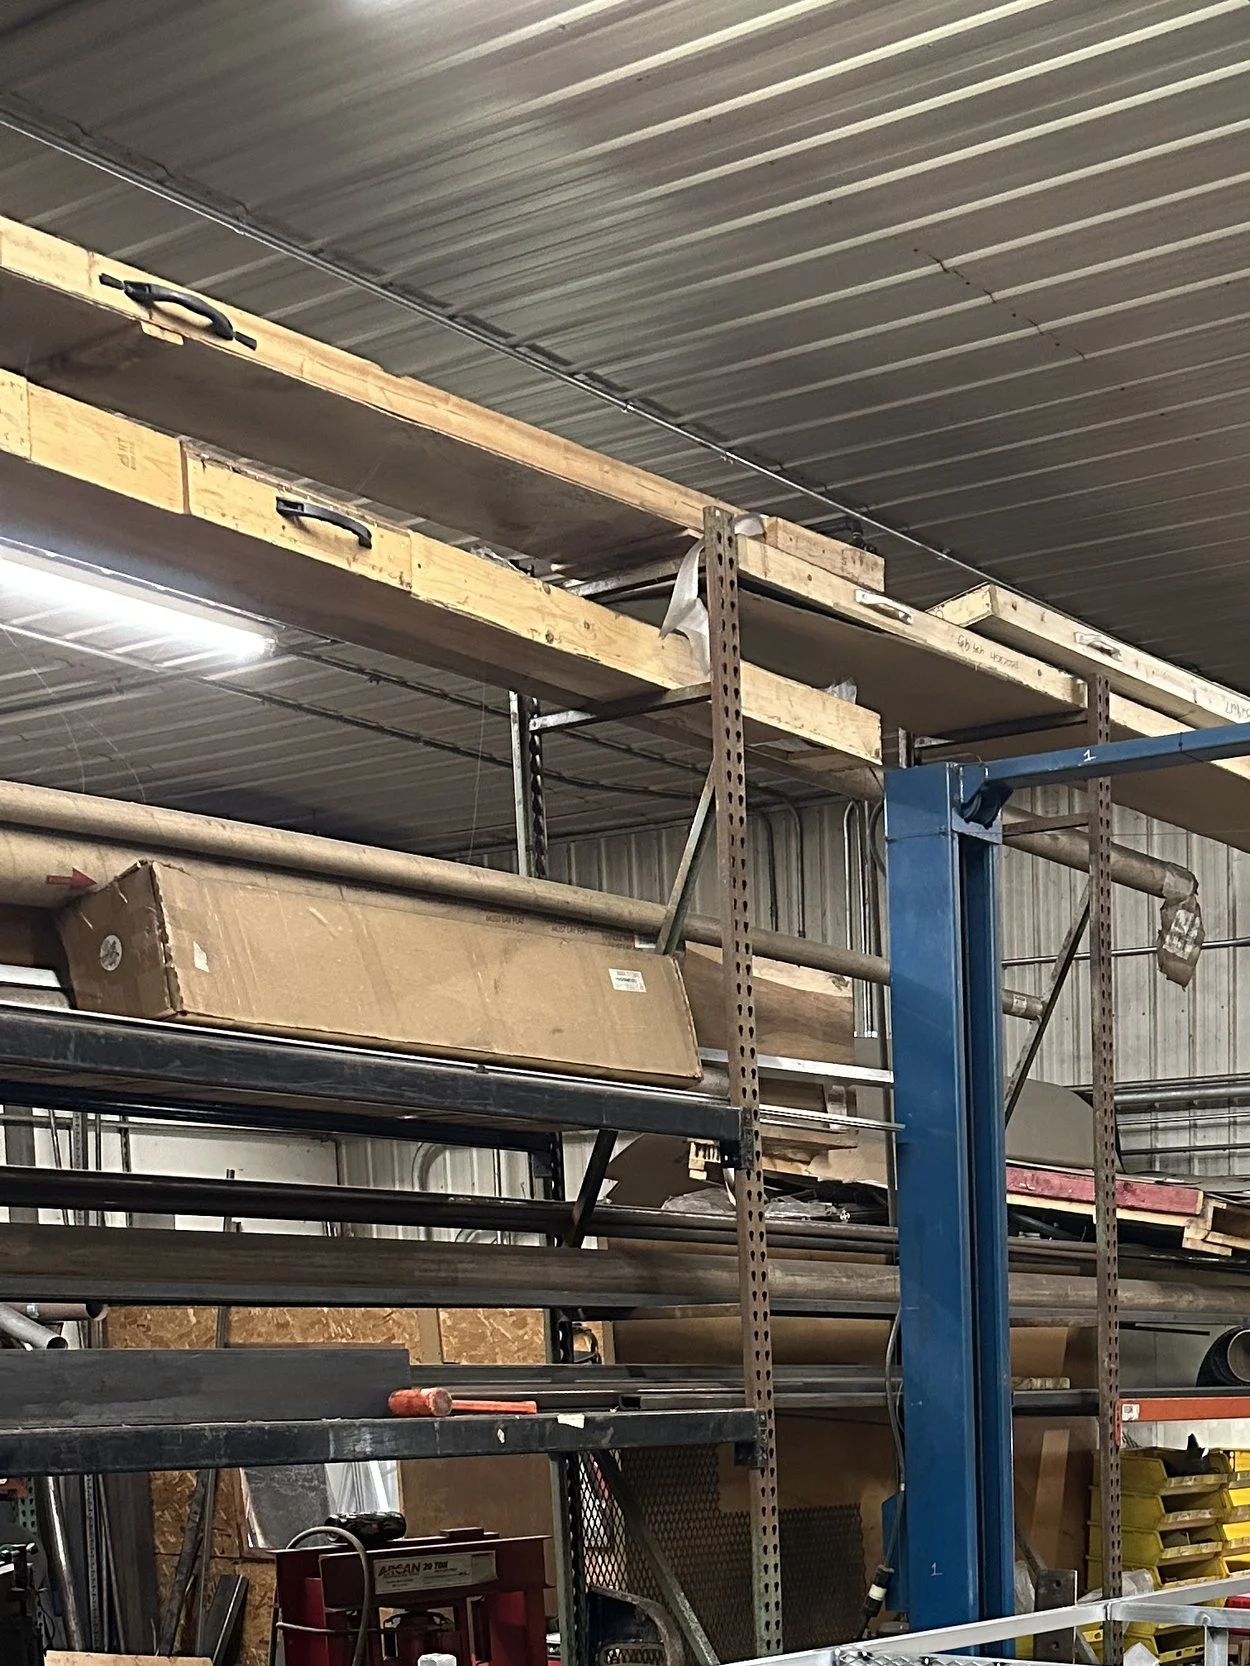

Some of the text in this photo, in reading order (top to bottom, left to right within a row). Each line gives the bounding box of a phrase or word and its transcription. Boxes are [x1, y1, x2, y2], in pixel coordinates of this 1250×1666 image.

[378, 1562, 420, 1576] ARCAN
[423, 1562, 433, 1571] 20
[434, 1561, 448, 1569] TON
